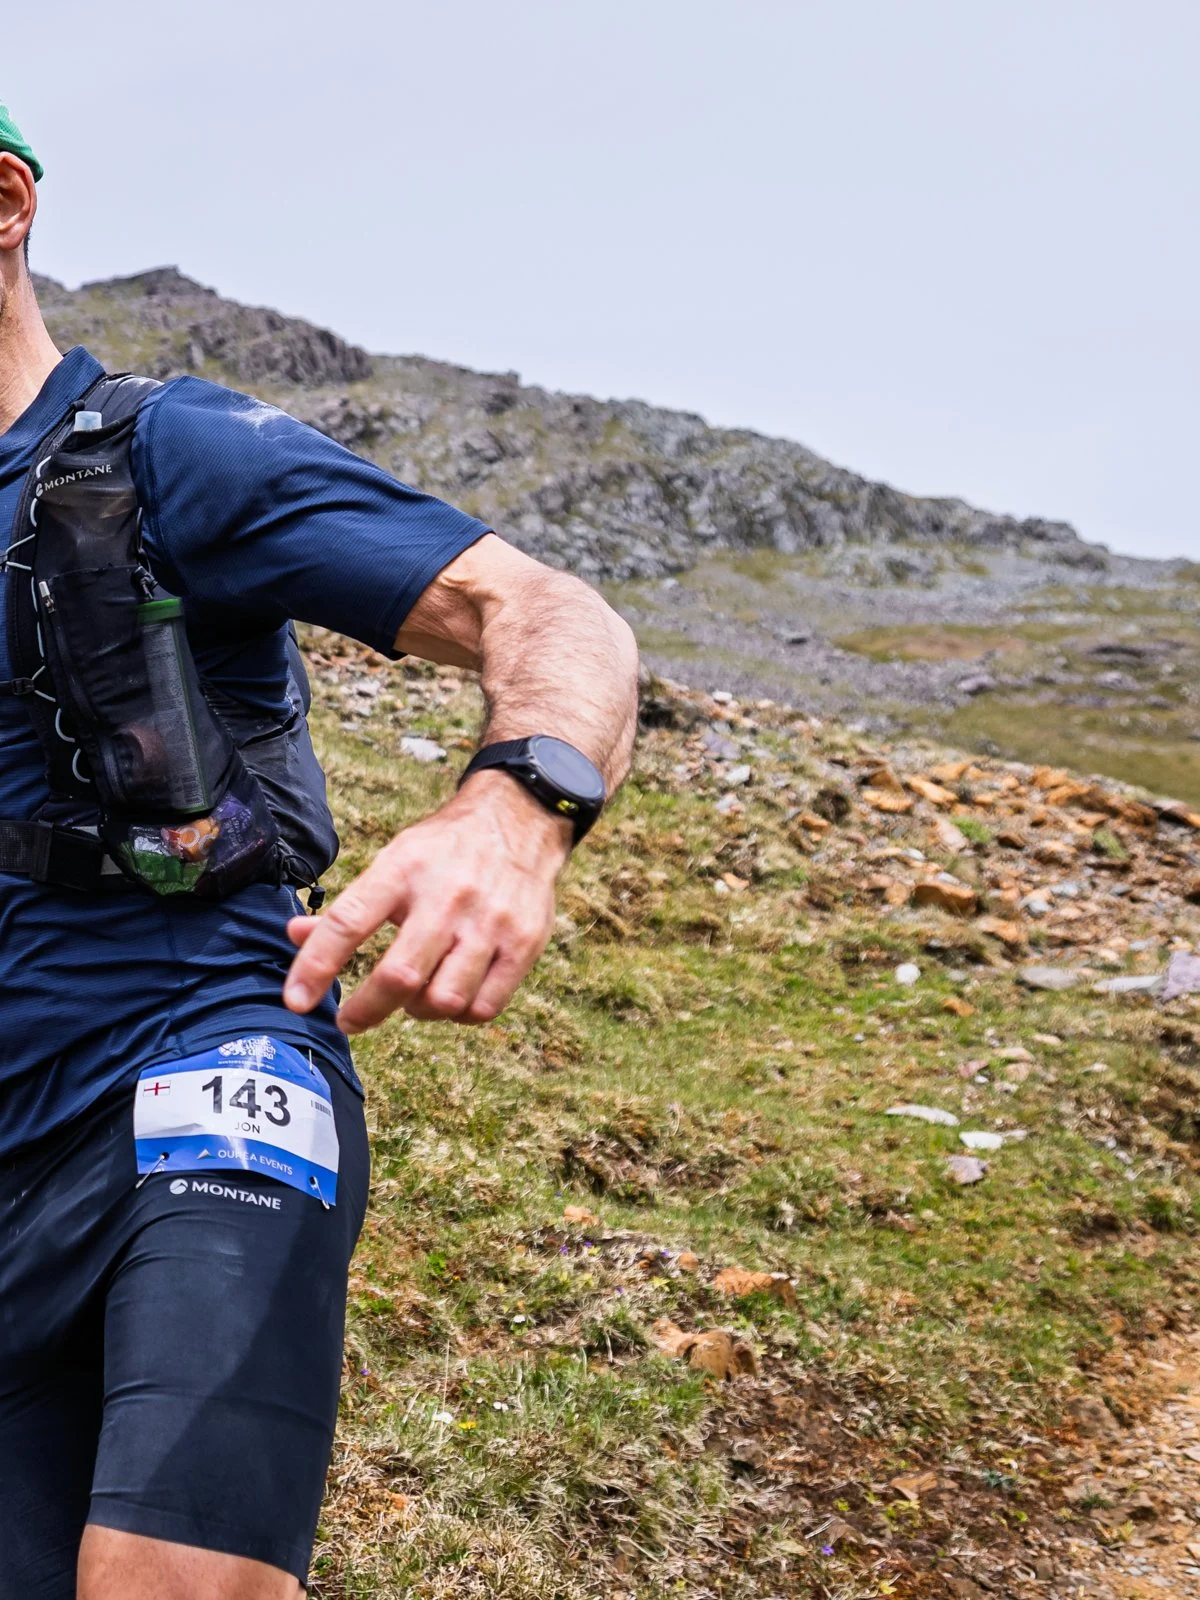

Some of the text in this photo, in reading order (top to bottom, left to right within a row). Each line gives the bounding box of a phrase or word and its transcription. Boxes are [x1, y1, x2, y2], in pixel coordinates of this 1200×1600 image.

[44, 463, 112, 492] MONTANE
[201, 1075, 291, 1127] 143
[233, 1121, 261, 1134] JON
[259, 1155, 294, 1176] EVENTS
[191, 1182, 282, 1210] MONTANE
